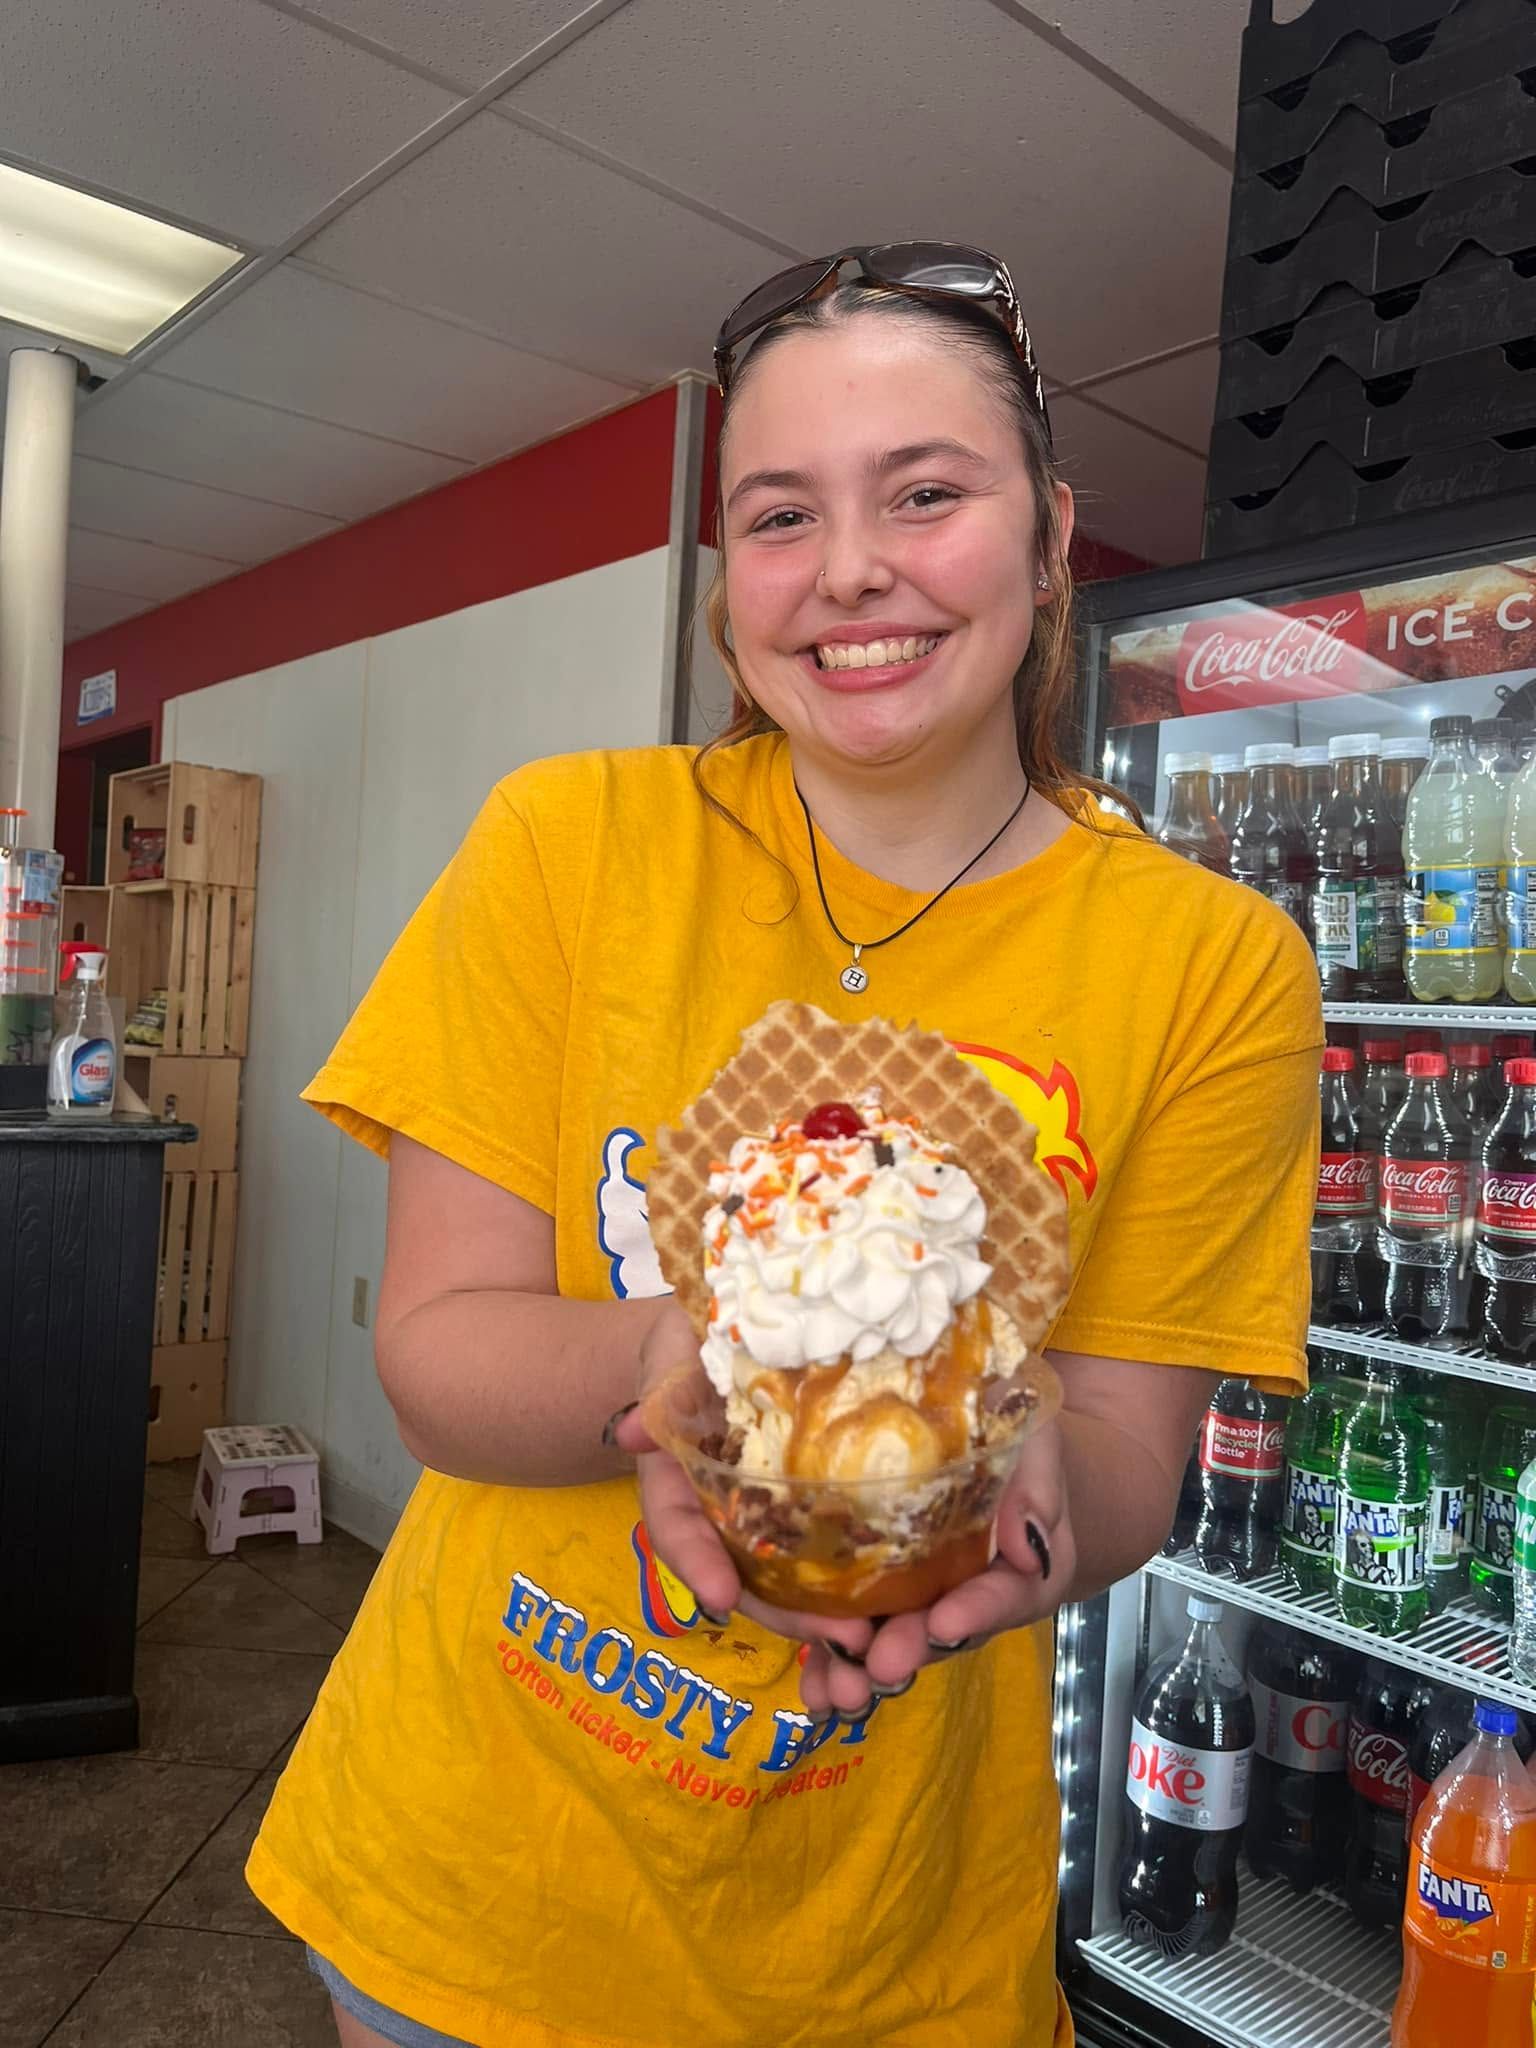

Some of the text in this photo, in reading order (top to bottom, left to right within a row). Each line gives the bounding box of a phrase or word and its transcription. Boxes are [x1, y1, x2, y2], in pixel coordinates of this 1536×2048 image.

[1387, 600, 1476, 651] ICE
[1185, 607, 1359, 692] Coca-Cola
[1318, 895, 1350, 916] OLD
[1319, 1158, 1372, 1184] ca-Cola
[1383, 1164, 1461, 1194] Coca-Cola
[1483, 1178, 1536, 1209] Coca-C
[1215, 1432, 1260, 1450] Recycled
[1239, 1428, 1262, 1439] 100
[1291, 1479, 1336, 1504] FANT
[1346, 1510, 1398, 1534] ANTA
[1482, 1496, 1515, 1522] FAN
[502, 1571, 754, 1761] FROSTY
[1291, 1704, 1341, 1752] Co
[567, 1691, 652, 1767] licked
[665, 1756, 762, 1811] Never
[1162, 1745, 1198, 1768] Diet
[1129, 1742, 1206, 1805] oke
[1418, 1861, 1494, 1914] FANTA
